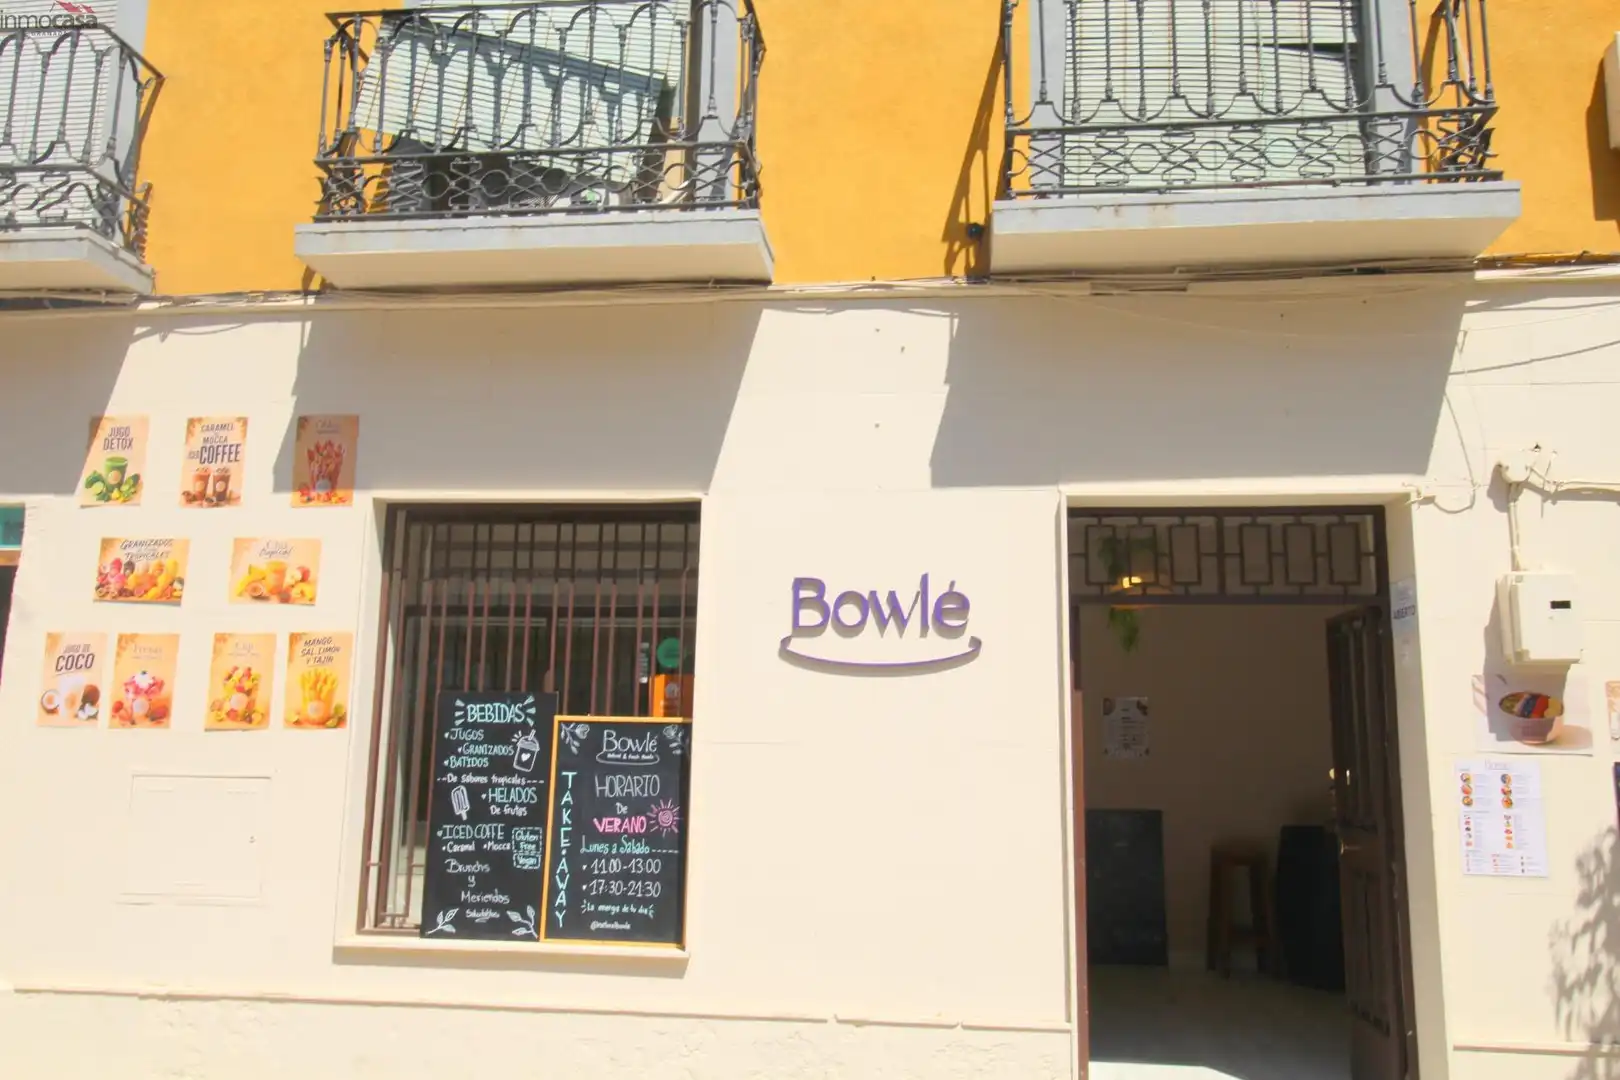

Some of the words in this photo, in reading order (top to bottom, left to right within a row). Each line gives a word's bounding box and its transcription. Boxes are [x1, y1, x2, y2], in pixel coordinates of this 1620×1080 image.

[107, 426, 130, 438] JUGO
[103, 437, 133, 451] DETOX
[202, 436, 228, 444] MOCCA
[199, 443, 242, 465] COFFEE
[791, 572, 970, 640] Bowlé
[55, 653, 96, 672] COCO
[466, 703, 525, 723] BEBIDAS
[450, 728, 485, 741] JUGOS
[602, 729, 658, 753] Bowlé
[463, 742, 515, 756] GRANIZADOS
[449, 756, 490, 768] BATIDOS
[447, 773, 458, 783] De
[594, 774, 660, 798] HORARIO
[488, 787, 538, 804] HELADOS
[490, 805, 501, 815] De
[503, 804, 528, 816] frutas
[615, 802, 628, 814] De
[442, 824, 473, 840] ICED
[474, 823, 506, 840] COFFE
[593, 816, 647, 833] VERANO
[487, 841, 511, 851] Mocca
[519, 841, 536, 851] Free
[580, 835, 610, 854] Lunes
[611, 843, 618, 854] a
[461, 888, 511, 904] Meriendas
